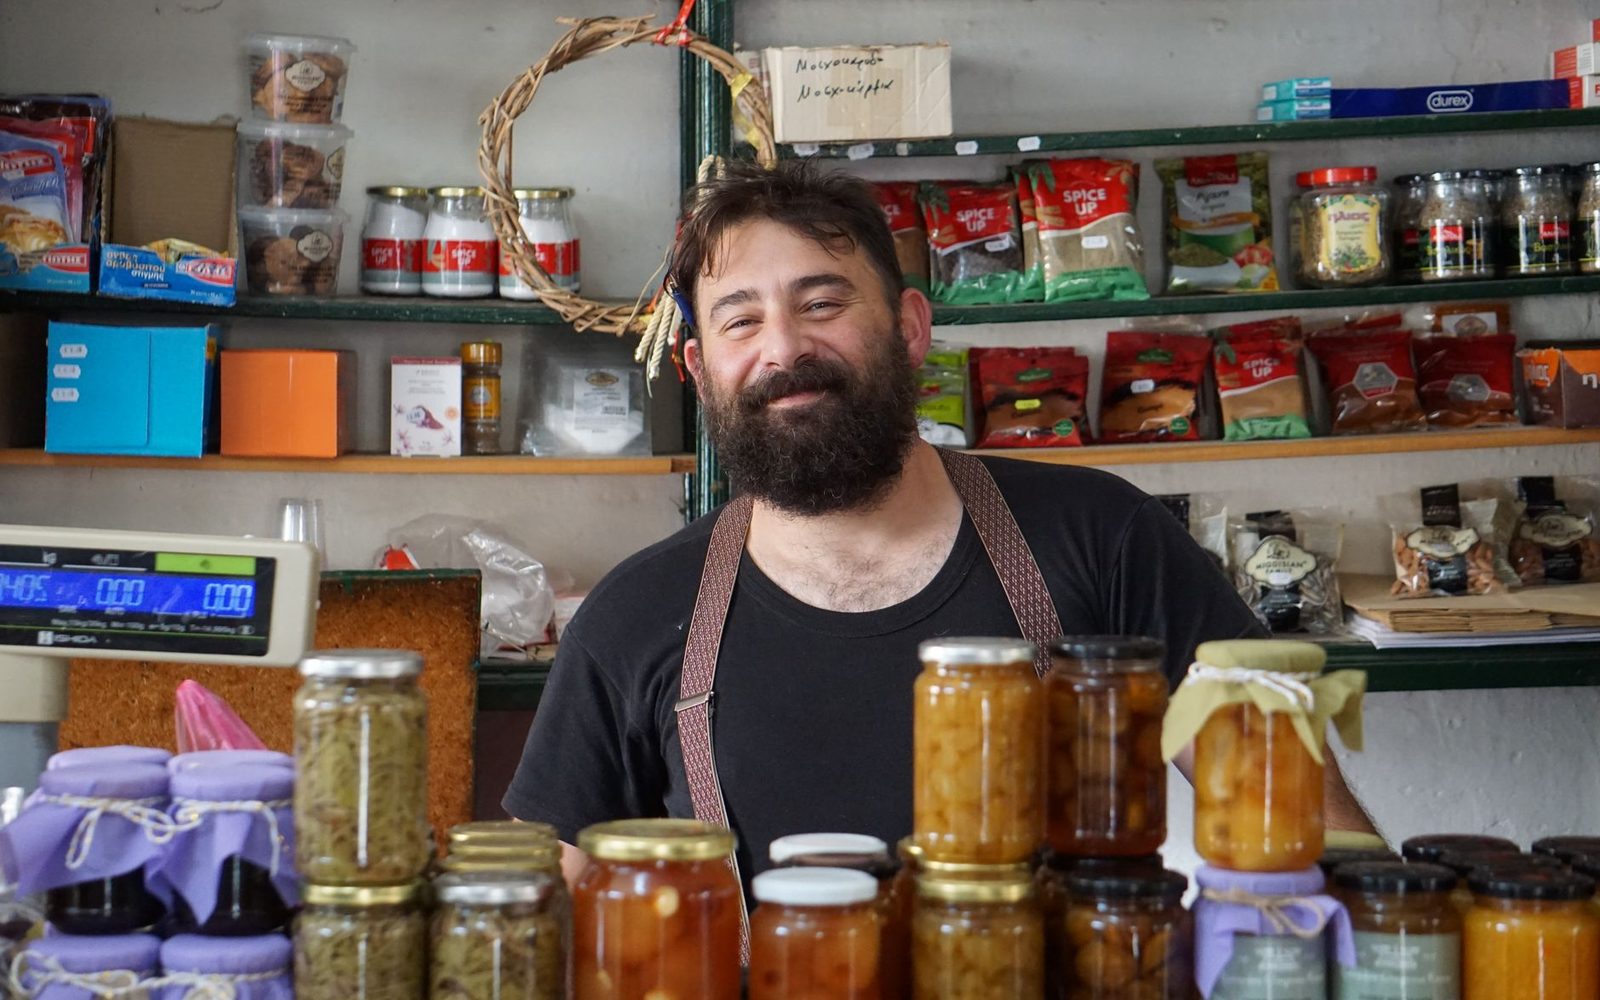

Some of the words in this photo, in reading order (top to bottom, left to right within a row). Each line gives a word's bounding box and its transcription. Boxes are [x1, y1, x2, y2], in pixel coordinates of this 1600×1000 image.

[1431, 94, 1468, 108] durex
[1063, 188, 1107, 203] SPICE
[956, 207, 995, 222] SPICE
[1074, 201, 1098, 216] UP
[965, 220, 987, 232] UP
[371, 247, 393, 256] SPICE
[451, 248, 477, 258] SPICE
[1252, 367, 1273, 378] UP
